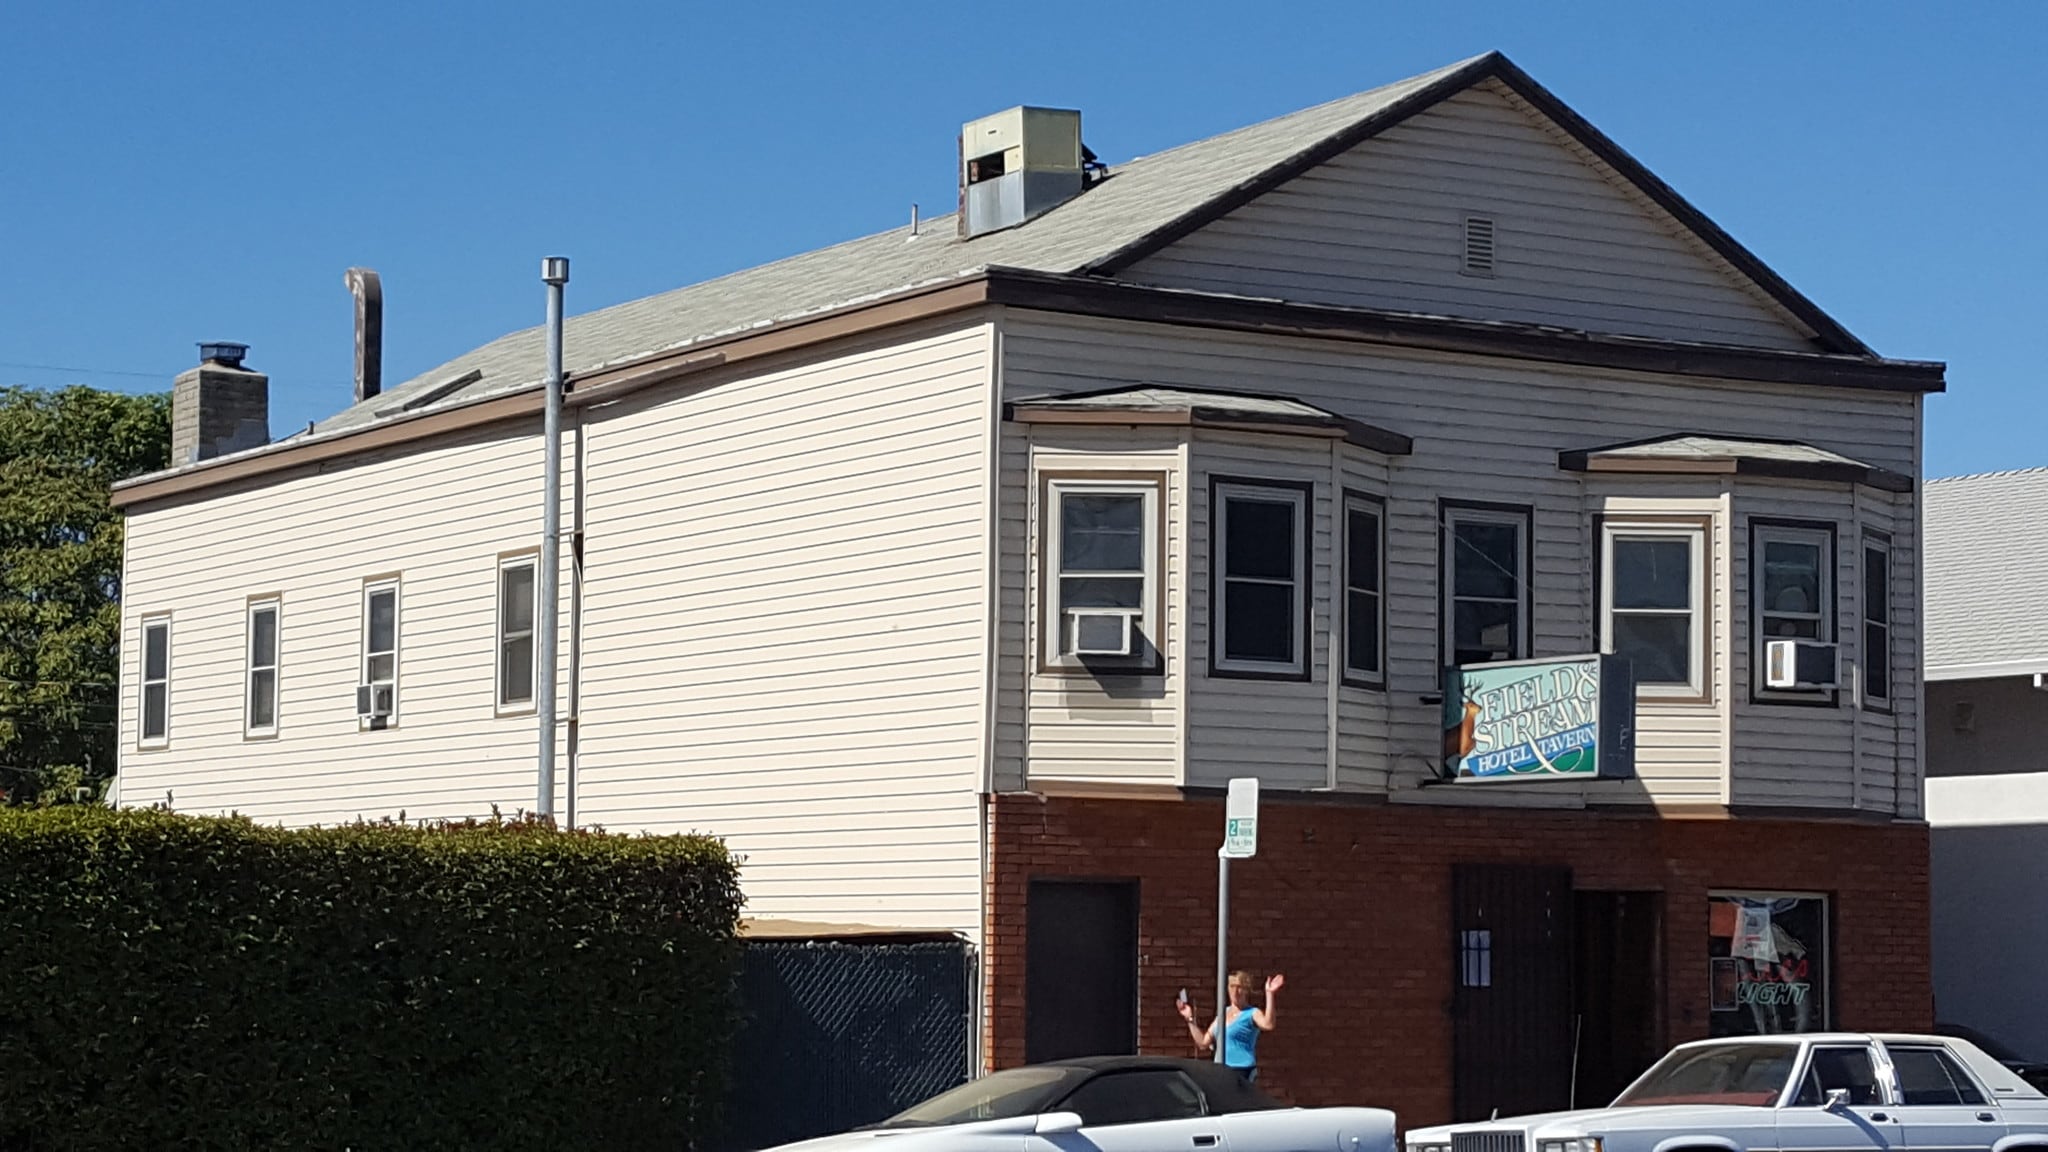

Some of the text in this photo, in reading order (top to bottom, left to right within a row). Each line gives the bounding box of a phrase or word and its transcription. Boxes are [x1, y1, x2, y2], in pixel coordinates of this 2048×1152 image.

[1480, 662, 1598, 722] FIELD &
[1473, 698, 1597, 760] STREAM
[1478, 727, 1596, 772] HOTEL TAVERN
[1230, 820, 1237, 836] 2
[1737, 983, 1810, 1005] LIGHT
